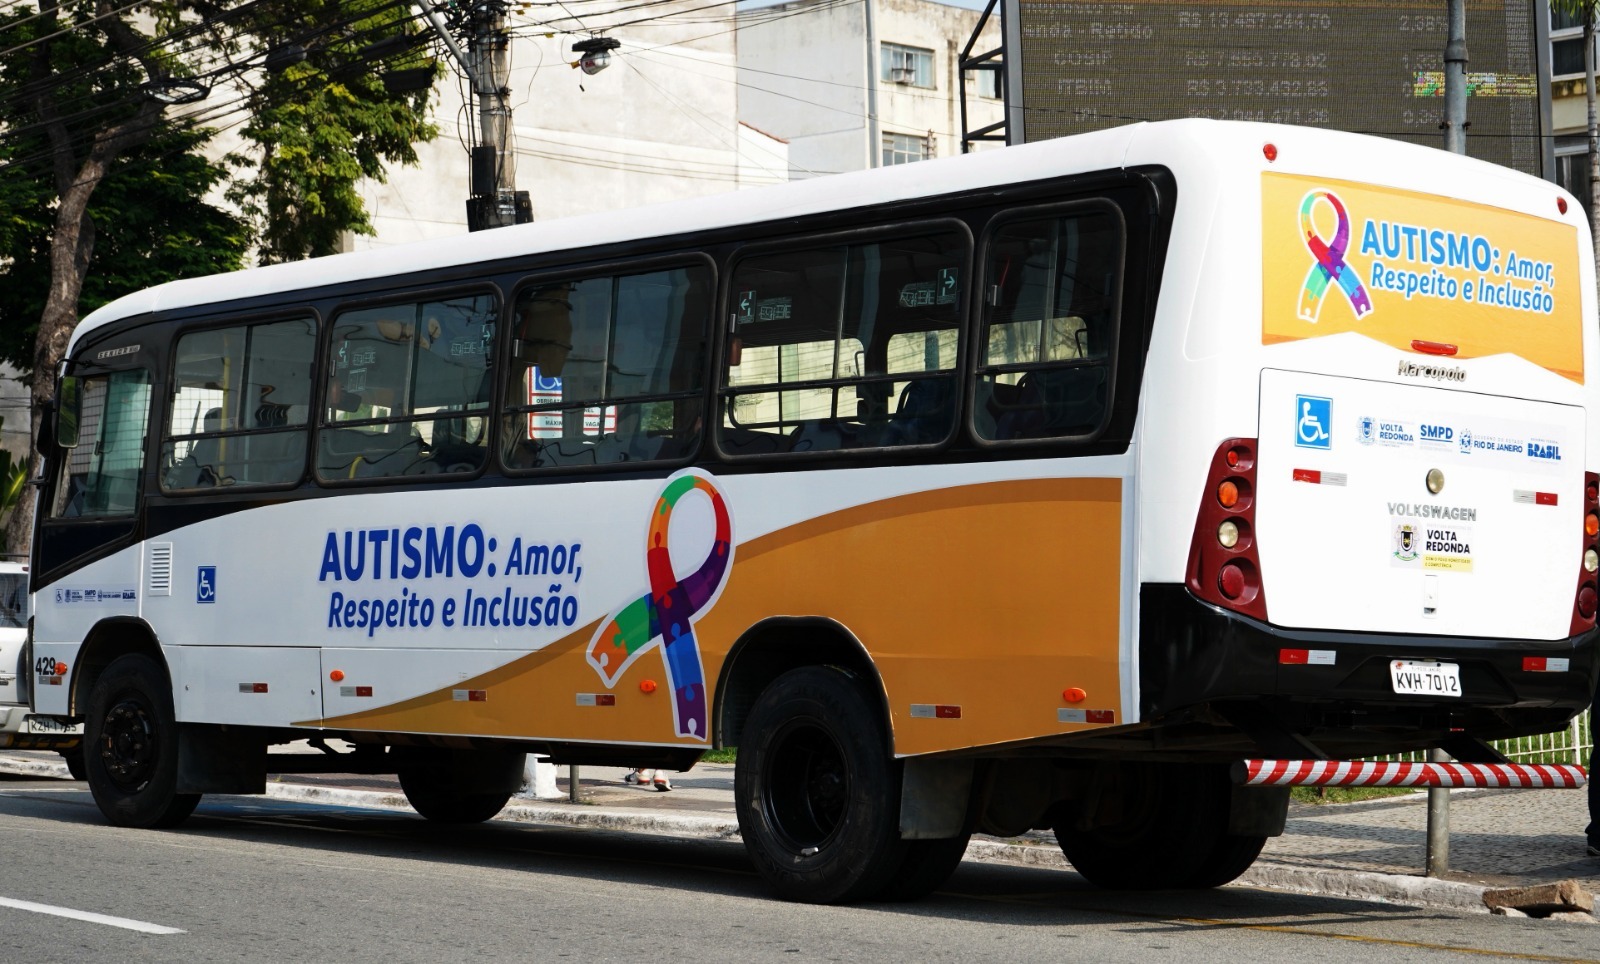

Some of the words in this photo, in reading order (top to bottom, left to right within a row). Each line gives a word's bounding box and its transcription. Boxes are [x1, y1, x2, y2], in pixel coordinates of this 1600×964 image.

[1361, 220, 1501, 274] AUTISMO:
[1506, 253, 1554, 288] Amor,
[1371, 262, 1457, 299] Respeito
[1463, 280, 1473, 299] e
[1478, 281, 1553, 314] Inclusão
[1398, 360, 1467, 383] Marcopolo
[1380, 423, 1404, 433] VOLTA
[1420, 424, 1453, 440] SMPD
[1380, 432, 1414, 443] REDONDA
[1474, 440, 1486, 449] RIO
[1486, 442, 1495, 450] DE
[1497, 443, 1523, 453] JANEIRO
[1527, 443, 1561, 460] BRASIL
[1387, 502, 1477, 522] VOLKSWAGEN
[1427, 529, 1457, 542] VOLTA
[319, 523, 497, 582] AUTISMO:
[504, 537, 582, 583] Amor,
[1426, 541, 1471, 554] REDONDA
[328, 587, 435, 637] Respeito
[442, 597, 455, 627] e
[463, 583, 578, 627] Inclusão
[35, 657, 56, 676] 429
